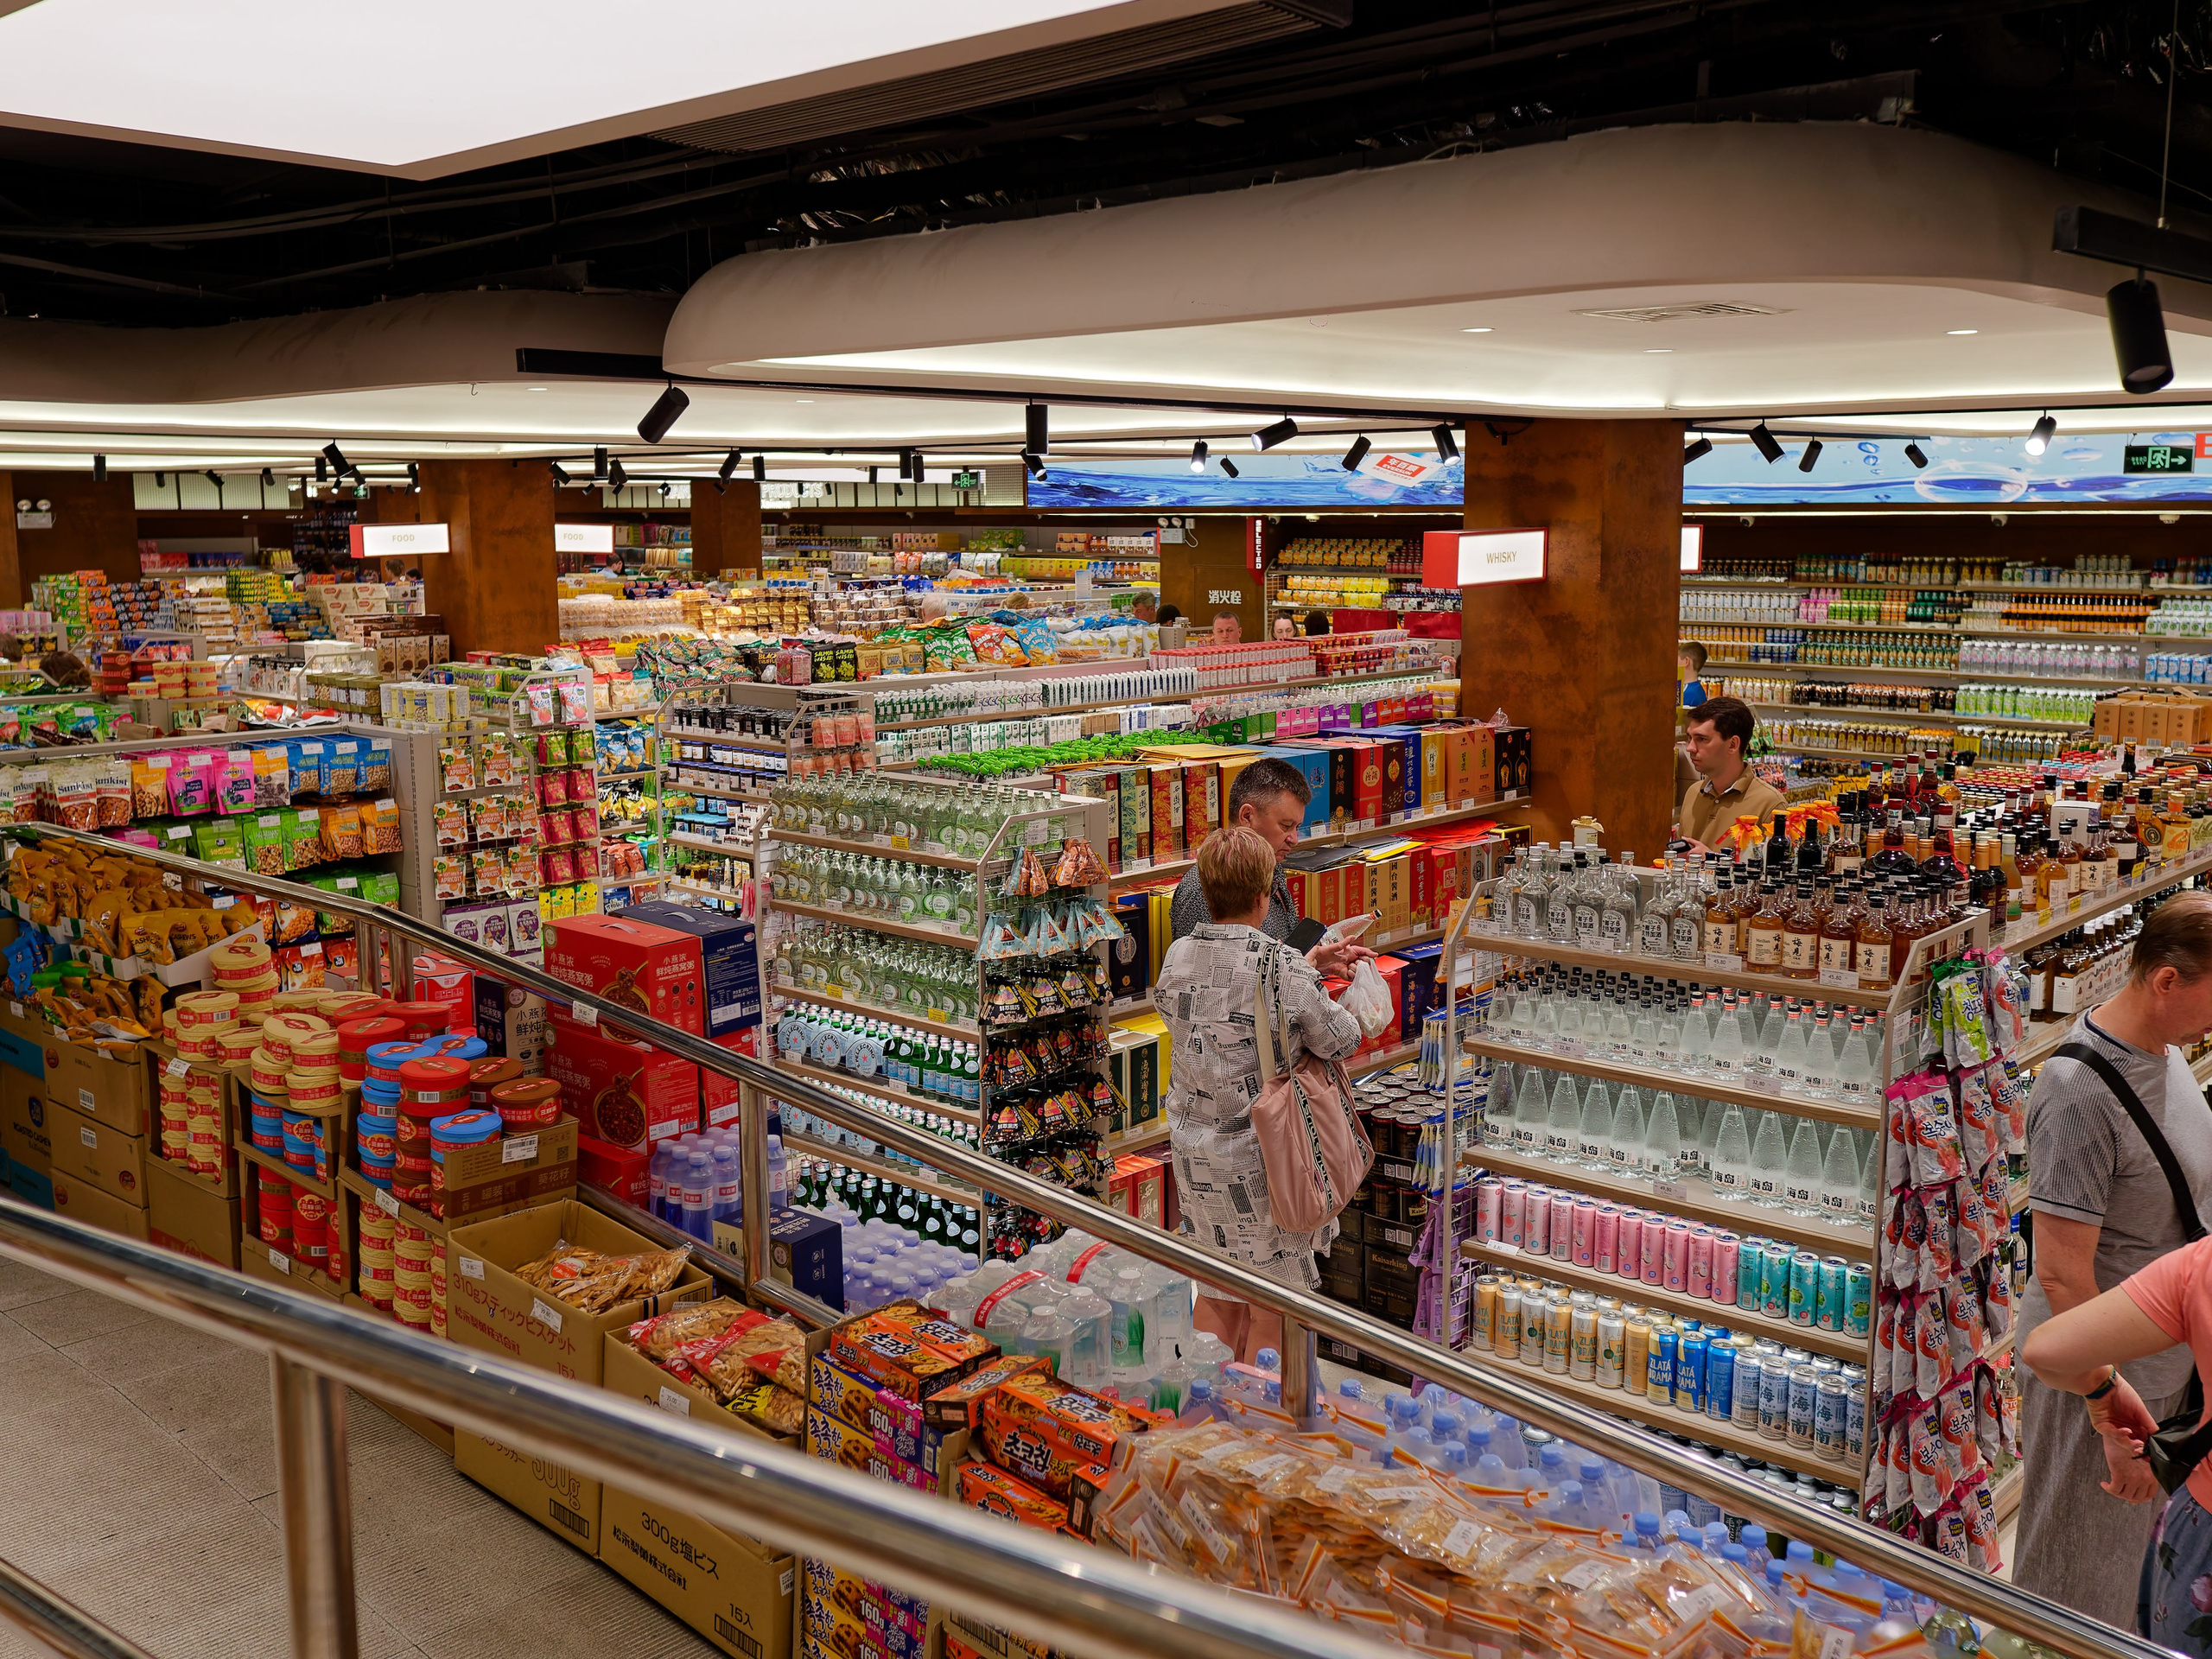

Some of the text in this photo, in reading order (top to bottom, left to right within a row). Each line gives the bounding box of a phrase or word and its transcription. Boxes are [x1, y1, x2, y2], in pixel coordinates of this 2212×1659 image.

[761, 483, 824, 499] PRODUCTS
[391, 534, 415, 543] FOOD
[563, 533, 584, 541] FOOD
[1486, 551, 1516, 564] WHISKY
[1208, 589, 1241, 605] 消火栓
[865, 658, 879, 668] CHIPS
[887, 655, 902, 665] CHIPS
[909, 653, 923, 664] CHIPS
[59, 782, 92, 794] Sunkist
[1714, 1059, 1730, 1068] 海岛
[1758, 1055, 1771, 1064] 海岛
[1779, 1068, 1795, 1077] 海岛
[1842, 1082, 1859, 1091] 海岛
[1997, 1081, 2023, 1107] 복숭아
[1547, 1135, 1566, 1148] 海岛
[1580, 1143, 1598, 1156] 海岛
[1714, 1171, 1735, 1185] 海岛
[1751, 1178, 1773, 1192] 海岛
[1191, 1182, 1212, 1192] taking
[1786, 1187, 1808, 1201] 海岛
[1821, 1193, 1842, 1208] 海岛
[1372, 1254, 1408, 1271] Kaisarking
[1547, 1328, 1567, 1339] ZLATÁ
[1580, 1335, 1597, 1346] ZLAT
[835, 1341, 858, 1363] 초코칩
[1650, 1357, 1671, 1372] ZLATÁ
[812, 1364, 844, 1400] 촉촉한
[820, 1395, 840, 1414] 초코칩
[1044, 1395, 1116, 1424] 초코칩
[1760, 1386, 1775, 1426] 海南
[868, 1408, 894, 1438] 160g
[1791, 1395, 1809, 1436] 海南
[1949, 1410, 1975, 1437] 복숭아
[809, 1413, 842, 1449] 촉촉한
[1816, 1403, 1833, 1445] 海南
[1002, 1430, 1053, 1473] 초코칩
[1073, 1433, 1104, 1456] 초코칩
[817, 1445, 837, 1464] 초코칩
[1050, 1456, 1068, 1474] 쿠키
[642, 1512, 720, 1580] 300g塩ビス
[806, 1556, 836, 1587] 촉촉한
[813, 1582, 831, 1601] 초코칩
[729, 1603, 754, 1631] 15入
[805, 1594, 835, 1632] 촉촉한
[859, 1599, 885, 1629] 160g
[812, 1627, 830, 1645] 초코칩
